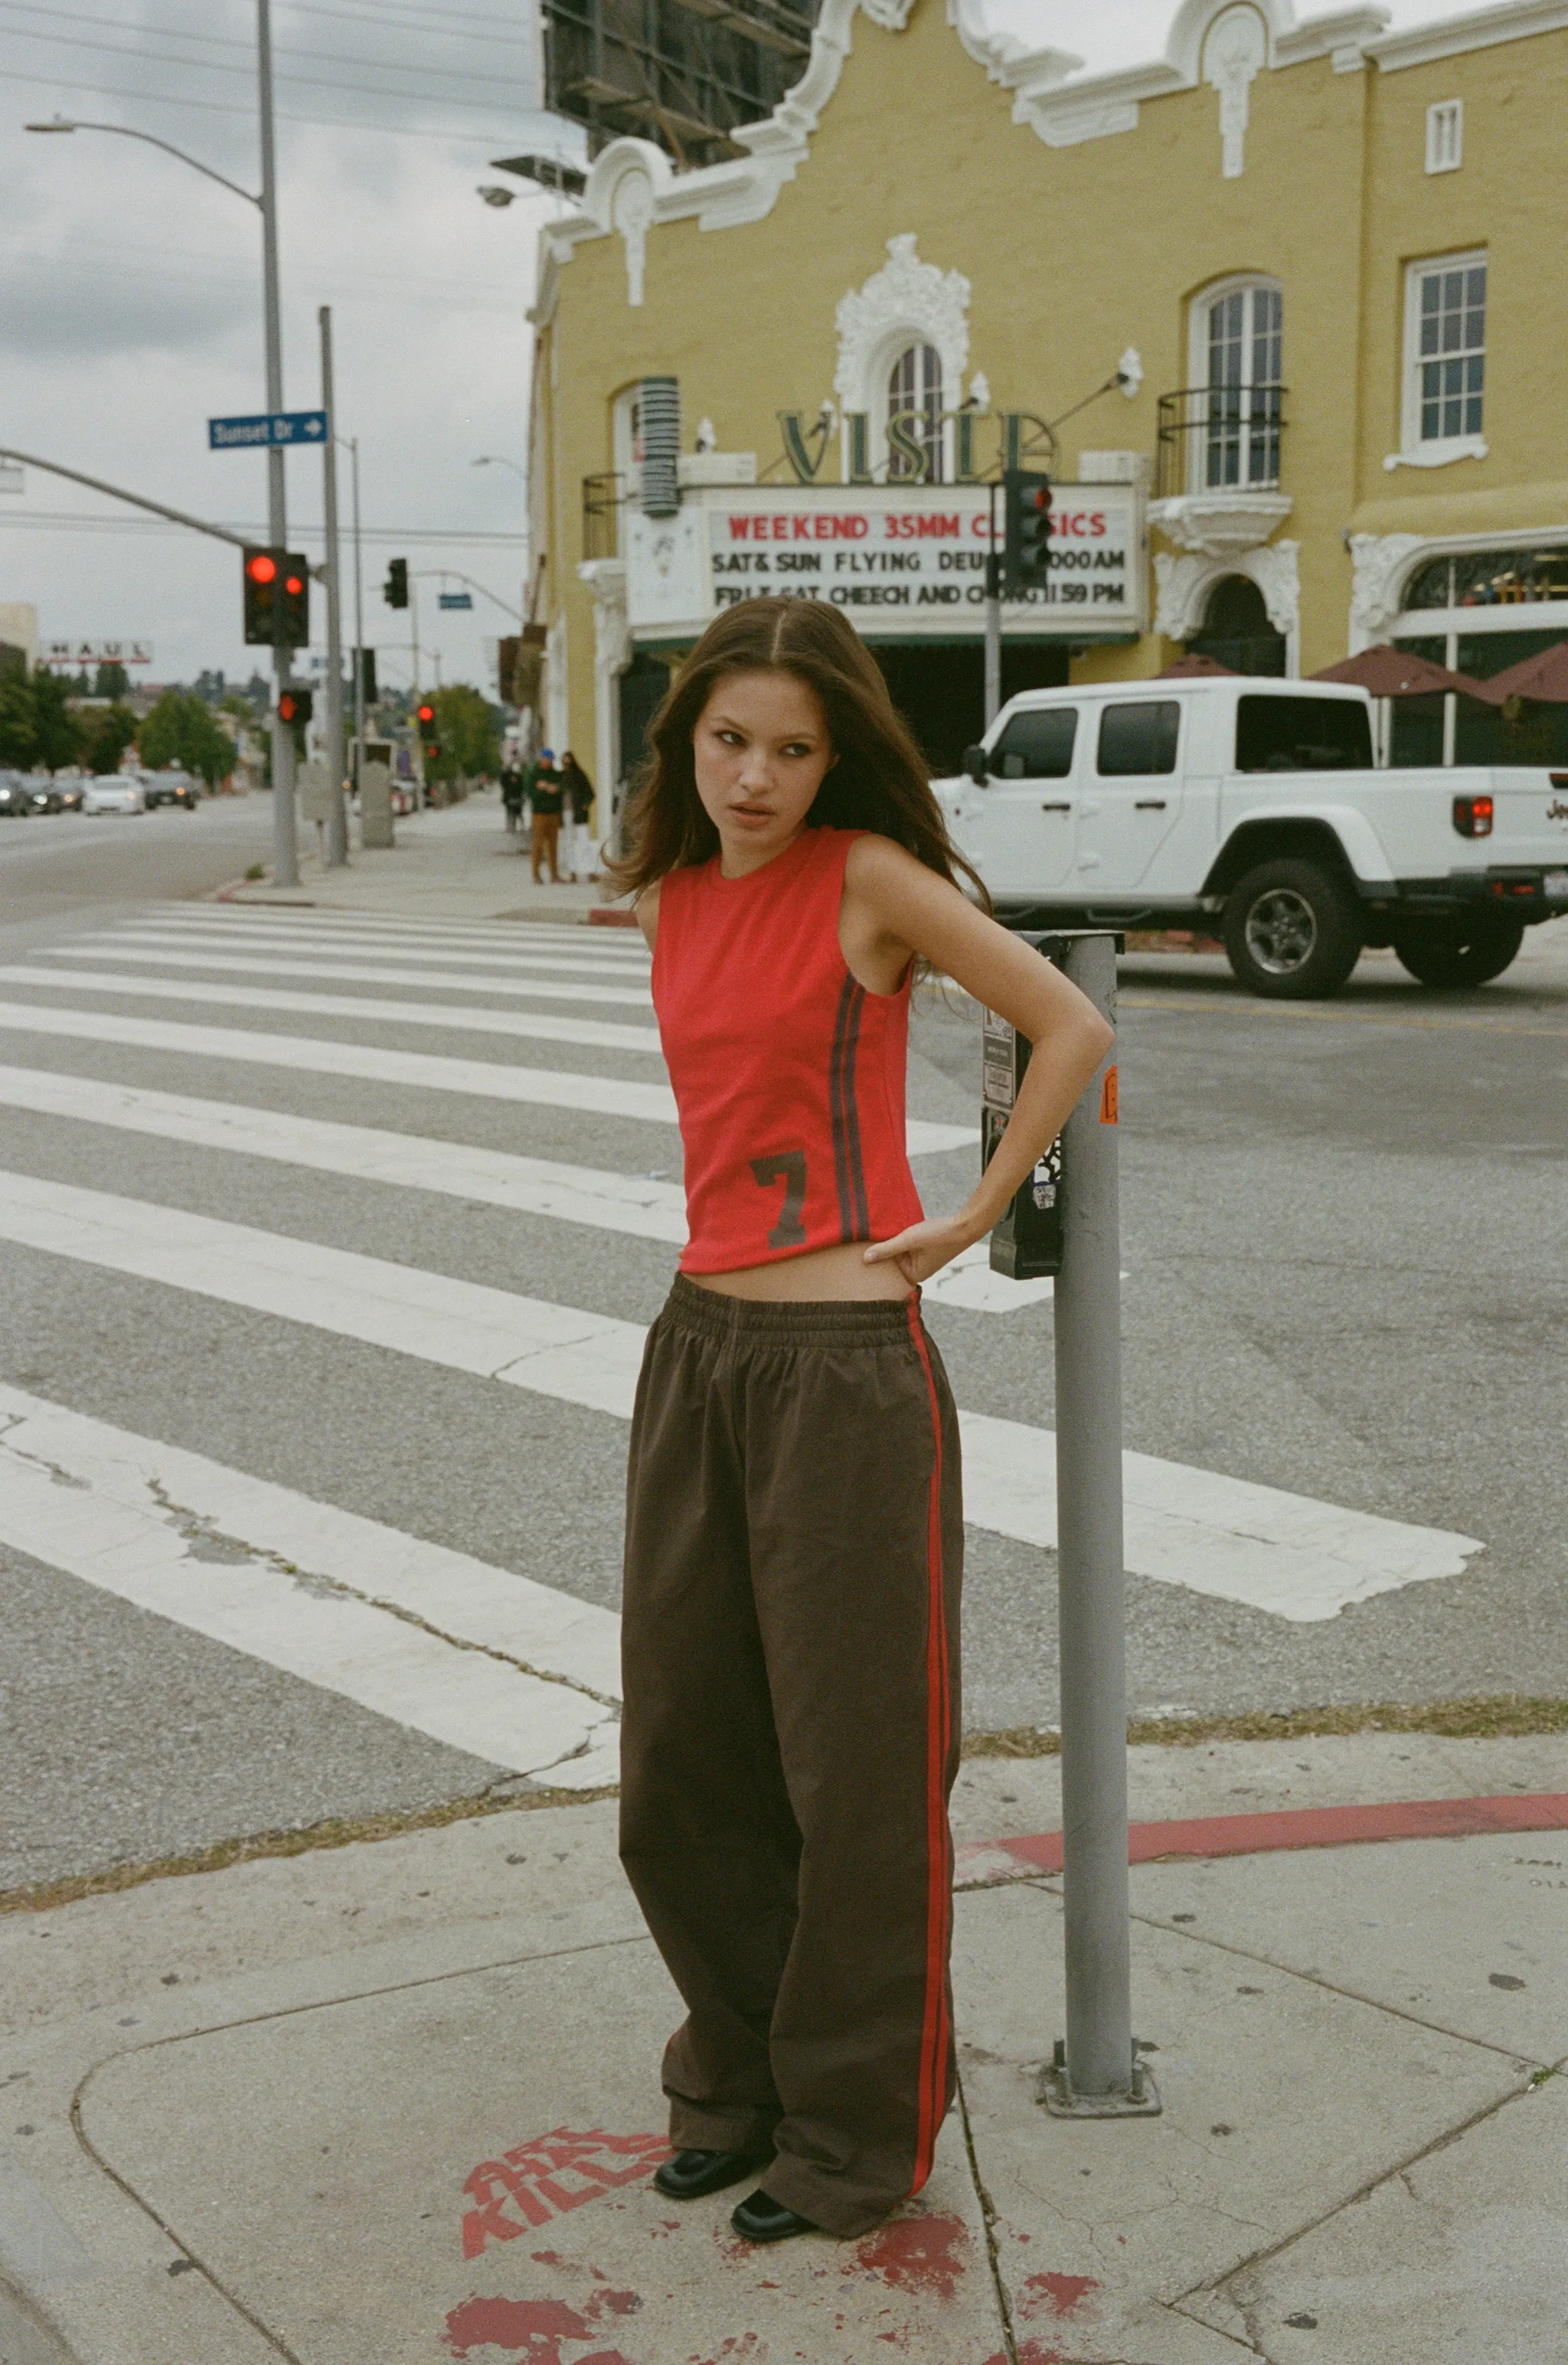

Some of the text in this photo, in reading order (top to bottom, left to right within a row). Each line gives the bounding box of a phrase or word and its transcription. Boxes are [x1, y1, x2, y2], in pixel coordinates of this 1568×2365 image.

[214, 419, 293, 443] Sunset Dr
[728, 514, 869, 541] WEEKEND
[884, 513, 960, 539] 35MM
[776, 551, 821, 572] SUN
[835, 550, 920, 572] FLYING
[829, 586, 910, 605] CHEECH
[917, 585, 961, 605] AND
[748, 1149, 807, 1249] 7
